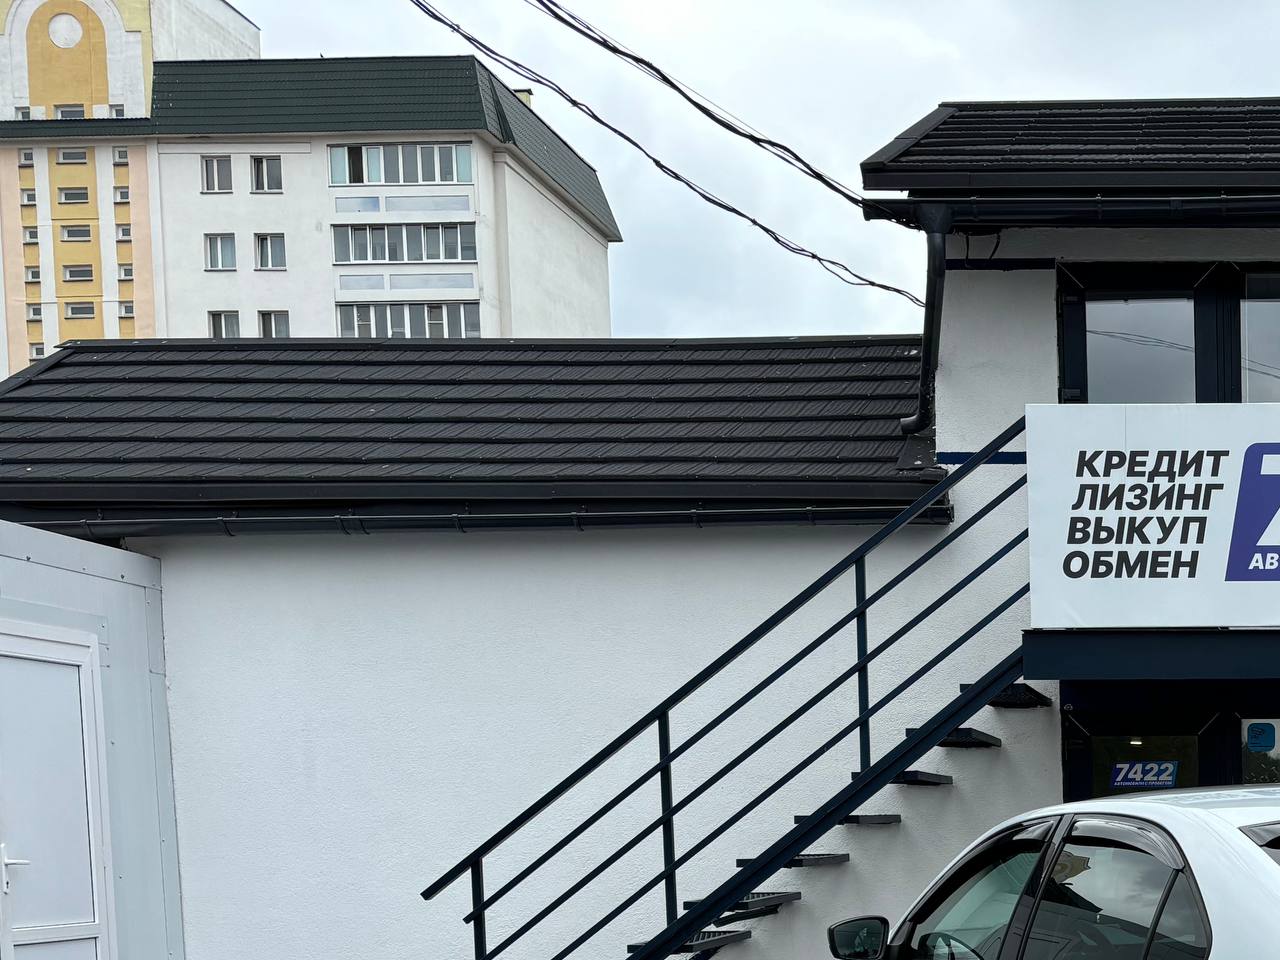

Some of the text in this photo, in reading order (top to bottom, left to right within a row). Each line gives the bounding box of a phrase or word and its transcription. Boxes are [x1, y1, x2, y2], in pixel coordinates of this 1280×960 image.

[1075, 450, 1230, 483] КРЕДИТ
[1071, 483, 1225, 511] ЛИЗИНГ
[1066, 516, 1208, 545] ВЫКУП
[1062, 550, 1200, 579] ОБМЕН
[1115, 762, 1175, 782] 7422
